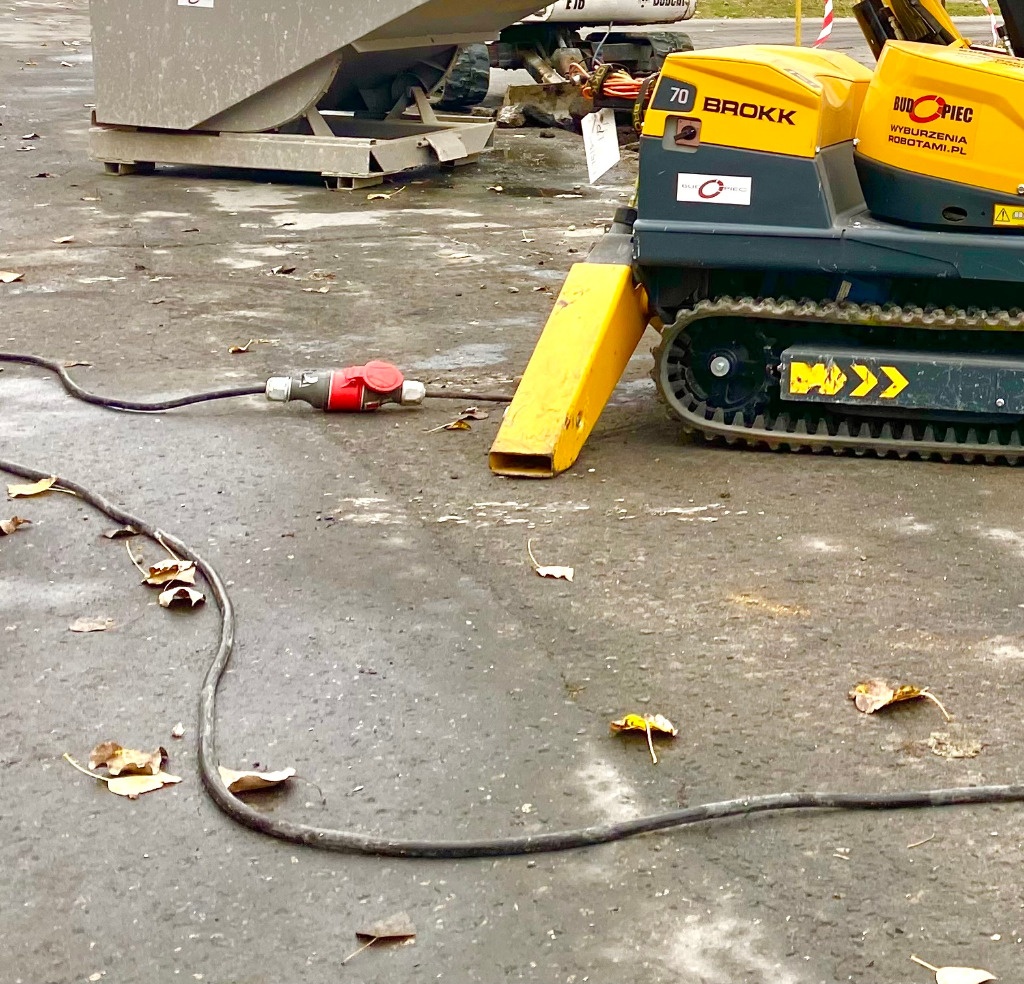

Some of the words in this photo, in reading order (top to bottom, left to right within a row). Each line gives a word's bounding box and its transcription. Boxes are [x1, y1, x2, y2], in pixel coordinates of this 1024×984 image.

[670, 87, 689, 104] 70
[702, 97, 797, 126] BROKK
[893, 96, 915, 114] BUD
[940, 103, 974, 123] PIEC
[890, 124, 967, 145] WYBURZENIA
[888, 135, 967, 156] ROBOTAMI.PL
